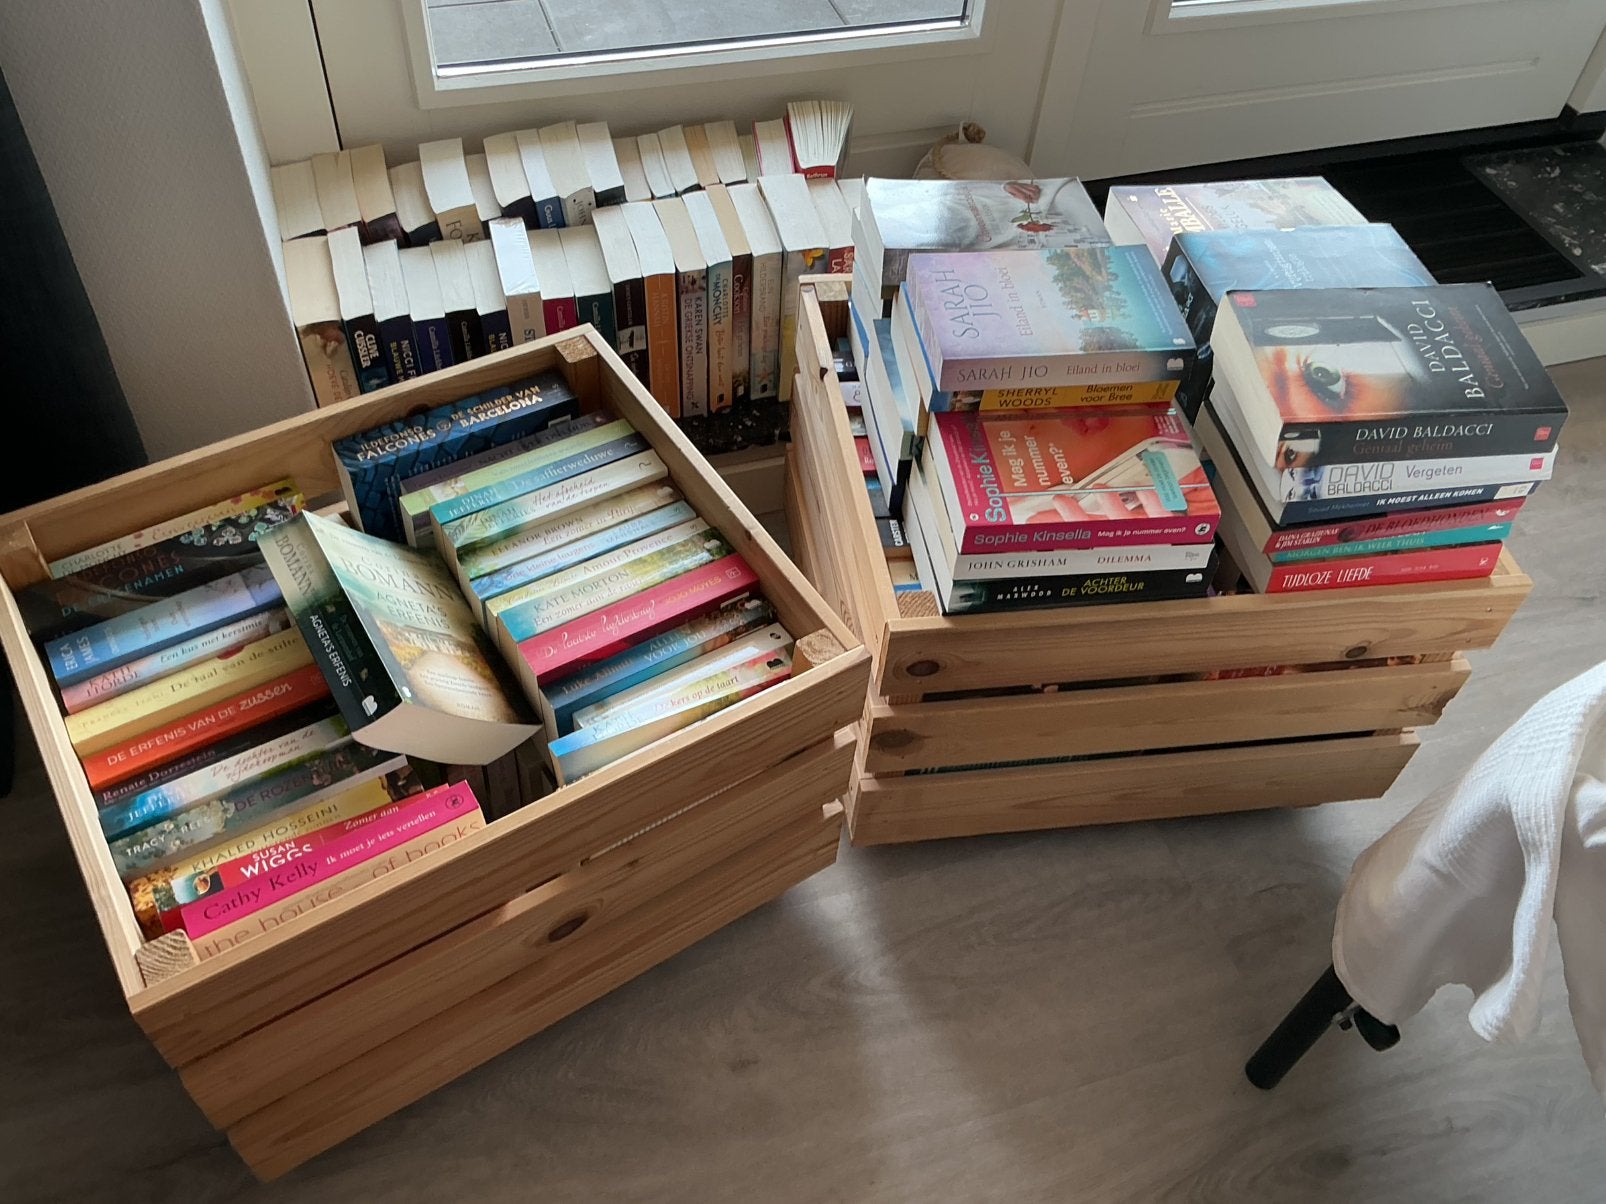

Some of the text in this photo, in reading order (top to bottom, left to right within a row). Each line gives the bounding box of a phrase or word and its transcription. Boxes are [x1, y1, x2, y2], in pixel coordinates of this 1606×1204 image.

[713, 281, 722, 326] MONCHY
[934, 268, 981, 340] SARAH
[963, 283, 1000, 319] JIO
[694, 296, 704, 355] KAREN SWAN
[1009, 304, 1034, 337] Eiland
[354, 330, 371, 369] CUSSLER
[365, 333, 380, 360] CLIVE
[389, 341, 404, 375] BLAUWE
[400, 339, 414, 368] NICCI
[1406, 322, 1446, 375] DAVID
[1410, 299, 1487, 401] BALDACCI
[956, 360, 1141, 383] SARAH JIO Eiland in bloei
[996, 386, 1059, 398] SHERRYL
[1080, 391, 1134, 403] voor Bree
[1086, 382, 1134, 393] Bloemen
[450, 385, 541, 422] DE SCHILDER VAN
[458, 394, 544, 429] BARCELONA
[999, 397, 1053, 409] WOODS
[356, 428, 437, 462] FALCONES
[360, 424, 424, 451] ILDEFONSO
[1355, 422, 1495, 442] DAVID BALDACCI
[998, 430, 1028, 488] Mag ik je
[1023, 435, 1052, 487] nummer
[1048, 442, 1074, 486] even?
[1328, 461, 1396, 483] DAVID
[1405, 463, 1464, 481] Vergeten
[977, 465, 1007, 523] Sophie
[1326, 478, 1394, 496] BALDACCI
[1375, 495, 1388, 507] IK
[1388, 493, 1418, 505] MOEST
[1417, 490, 1451, 503] ALLEEN
[1450, 487, 1484, 499] KOMEN
[542, 516, 585, 537] BROWN
[973, 532, 1029, 547] Sophie
[1032, 528, 1093, 544] Kinsella
[1097, 529, 1114, 540] Mag
[1131, 527, 1163, 537] nummer
[1163, 525, 1187, 536] even?
[275, 533, 317, 599] BOMANN
[582, 533, 674, 575] Amour Provence
[968, 553, 1153, 572] JOHN GRISHAM DILEMMA
[339, 556, 455, 602] BOMANN
[533, 593, 570, 614] KATE
[569, 567, 630, 606] MORTON
[1012, 583, 1040, 593] ALEX
[1061, 581, 1146, 598] DE VOORDEUR
[1083, 575, 1127, 587] ACHTER
[1282, 566, 1374, 589] TIJDLOZE LIEFDE
[375, 590, 448, 618] AGNETA'S
[996, 589, 1053, 601] MARWOOD
[388, 606, 452, 631] ERFENIS
[533, 600, 584, 626] Een zomer
[159, 636, 220, 664] Een kus met
[309, 613, 336, 657] AGNETA'S
[330, 652, 353, 688] ERFENIS
[643, 629, 708, 662] VOOR JOU
[170, 635, 301, 694] De taal van de stilte
[561, 676, 593, 695] Luke
[704, 681, 717, 696] de
[716, 675, 741, 693] taart
[106, 679, 294, 767] DE ERFENIS VAN DE zussen
[102, 777, 146, 802] Renate
[148, 748, 217, 783] Dorrestein
[233, 794, 259, 814] DE
[342, 804, 400, 832] Zomer aan
[125, 834, 167, 858] TRACY
[191, 802, 339, 873] KHALED HOSSEINI
[325, 810, 438, 867] Ik moet je iets vertellen
[239, 842, 314, 880] WIGGS
[251, 840, 297, 864] SUSAN
[202, 860, 320, 922] Cathy Kelly
